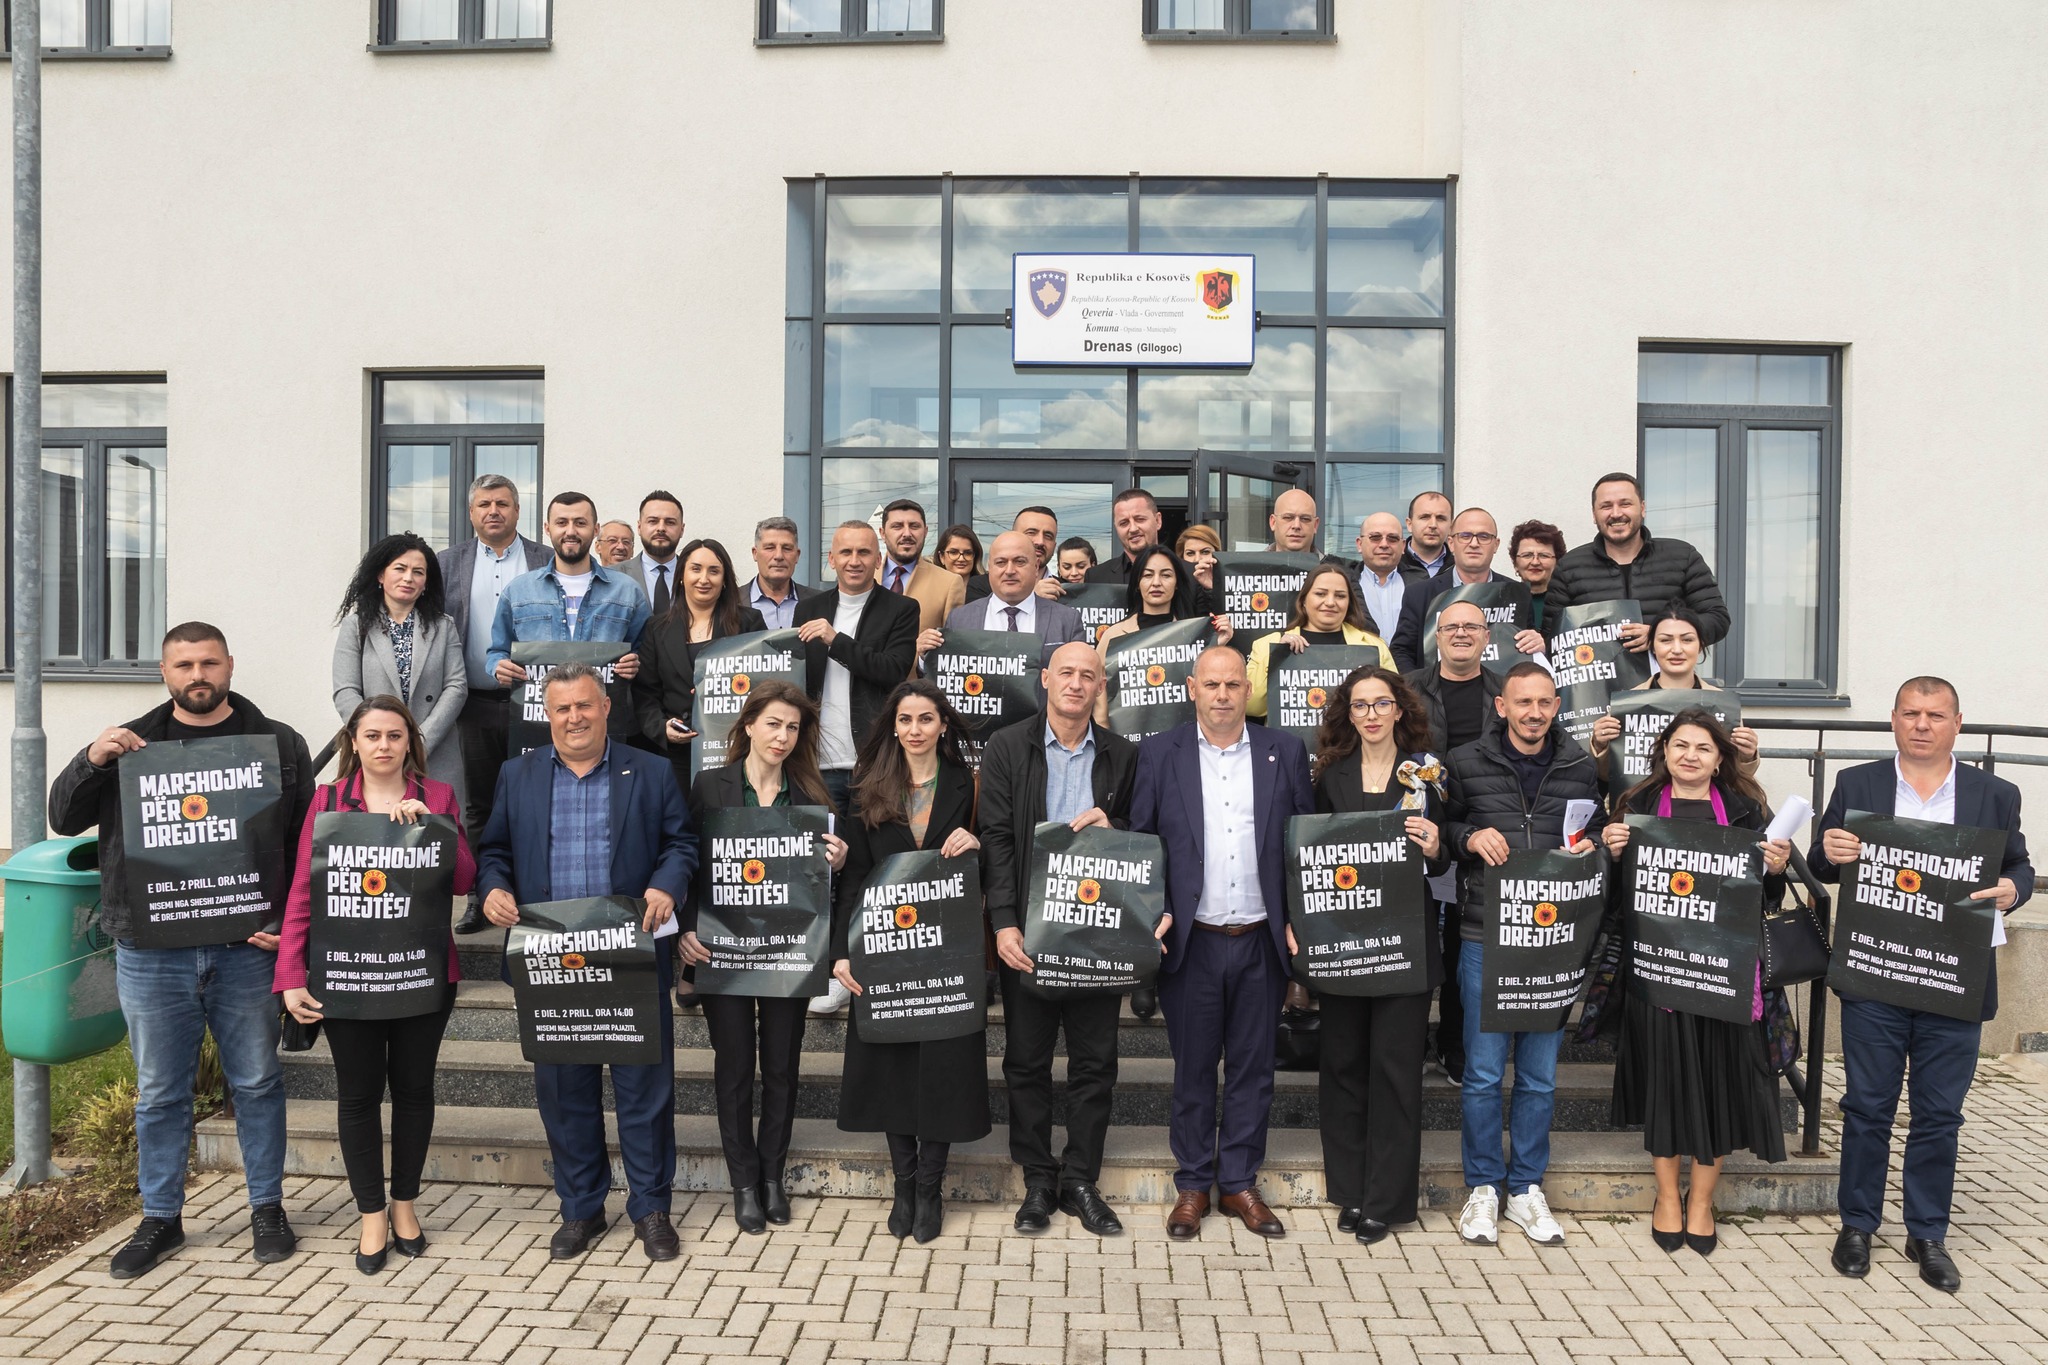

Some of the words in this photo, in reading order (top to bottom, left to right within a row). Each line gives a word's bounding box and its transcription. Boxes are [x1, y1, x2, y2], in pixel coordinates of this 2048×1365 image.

[1076, 272, 1133, 283] Republika
[1146, 272, 1191, 282] Kosovës
[1071, 295, 1104, 304] Republika
[1081, 307, 1114, 319] Qeveria
[1119, 309, 1139, 318] Vlada
[1144, 309, 1184, 318] Government
[1085, 323, 1119, 333] Komuna
[1084, 339, 1133, 352] Drenas
[1136, 342, 1182, 354] (Gllogoc)
[1225, 592, 1251, 611] PËR
[1551, 619, 1631, 653] MARSHOJM
[705, 650, 792, 675] MARSHOJMË
[937, 654, 1027, 676] MARSHOJMË
[1552, 648, 1575, 671] PËR
[704, 674, 730, 695] PËR
[937, 672, 964, 694] PËR
[1119, 666, 1146, 688] PËR
[1555, 660, 1617, 689] DREJTËSI
[1121, 682, 1186, 707] DREJTËSI
[1280, 686, 1307, 707] PËR
[703, 741, 707, 749] E
[140, 761, 263, 797] MARSHOJMË
[142, 796, 181, 823] PËR
[143, 815, 238, 848] DREJTËSI
[712, 831, 814, 858] MARSHOJMË
[328, 841, 441, 869] MARSHOJMË
[1300, 836, 1407, 867] MARSHOJMË
[1637, 845, 1750, 879] MARSHOJMË
[1860, 841, 1983, 883] MARSHOJMË
[328, 867, 361, 894] PËR
[712, 858, 742, 883] PËR
[1048, 853, 1152, 885] MARSHOJMË
[1301, 865, 1334, 891] PËR
[1635, 866, 1669, 893] PËR
[1858, 862, 1896, 888] PËR
[148, 883, 153, 893] E
[181, 880, 186, 890] 2
[218, 876, 235, 886] ORA
[237, 873, 259, 884] 14:00
[713, 880, 788, 905] DREJTËSI
[863, 872, 964, 908] MARSHOJMË
[1045, 874, 1078, 901] PËR
[1500, 872, 1603, 901] MARSHOJMË
[149, 902, 173, 910] NISEMI
[175, 900, 189, 908] NGA
[190, 897, 214, 907] SHESHI
[215, 895, 234, 904] ZAHIR
[327, 893, 411, 919] DREJTËSI
[1303, 885, 1382, 914] DREJTËSI
[1500, 899, 1533, 925] PËR
[1634, 891, 1716, 923] DREJTËSI
[1856, 884, 1944, 922] DREJTËSI
[151, 912, 160, 922] NË
[161, 910, 190, 921] DREJTIM
[191, 908, 199, 918] TË
[200, 908, 228, 918] SHESHIT
[863, 906, 895, 932] PËR
[1042, 901, 1121, 929] DREJTËSI
[524, 922, 636, 955] MARSHOJMË
[713, 936, 718, 944] E
[740, 937, 744, 946] 2
[770, 935, 785, 945] ORA
[787, 935, 806, 944] 14:00
[864, 923, 942, 954] DREJTËSI
[1309, 947, 1313, 955] E
[1334, 943, 1339, 952] 2
[1365, 938, 1380, 948] ORA
[1381, 935, 1401, 946] 14:00
[1500, 922, 1574, 948] DREJTËSI
[327, 951, 332, 961] E
[354, 953, 359, 962] 2
[389, 951, 405, 962] ORA
[407, 949, 425, 960] 14:00
[525, 954, 561, 970] PËR
[1634, 941, 1638, 950] E
[1658, 946, 1663, 956] 2
[1689, 953, 1706, 965] ORA
[1707, 955, 1729, 968] 14:00
[1851, 932, 1857, 942] E
[1879, 940, 1885, 950] 2
[1915, 948, 1933, 961] ORA
[1935, 952, 1959, 966] 14:00
[1038, 954, 1043, 962] E
[1064, 957, 1069, 966] 2
[1096, 960, 1111, 970] ORA
[1114, 962, 1133, 971] 14:00
[1847, 959, 1856, 969] NË
[1856, 961, 1882, 976] DREJTIM
[1883, 968, 1891, 978] TË
[1891, 972, 1919, 985] SHESHIT
[1849, 949, 1870, 961] NISEMI
[1871, 956, 1884, 966] NGA
[1884, 959, 1908, 971] SHESHI
[1909, 964, 1928, 976] ZAHIR
[528, 967, 613, 985] DREJTËSI
[869, 986, 874, 995] E
[896, 983, 900, 991] 2
[927, 978, 942, 988] ORA
[944, 975, 964, 986] 14:00
[1499, 977, 1503, 985] E
[1525, 977, 1530, 985] 2
[1556, 974, 1570, 983] ORA
[535, 1010, 539, 1018] E
[595, 1009, 611, 1017] ORA
[613, 1008, 633, 1017] 14:00
